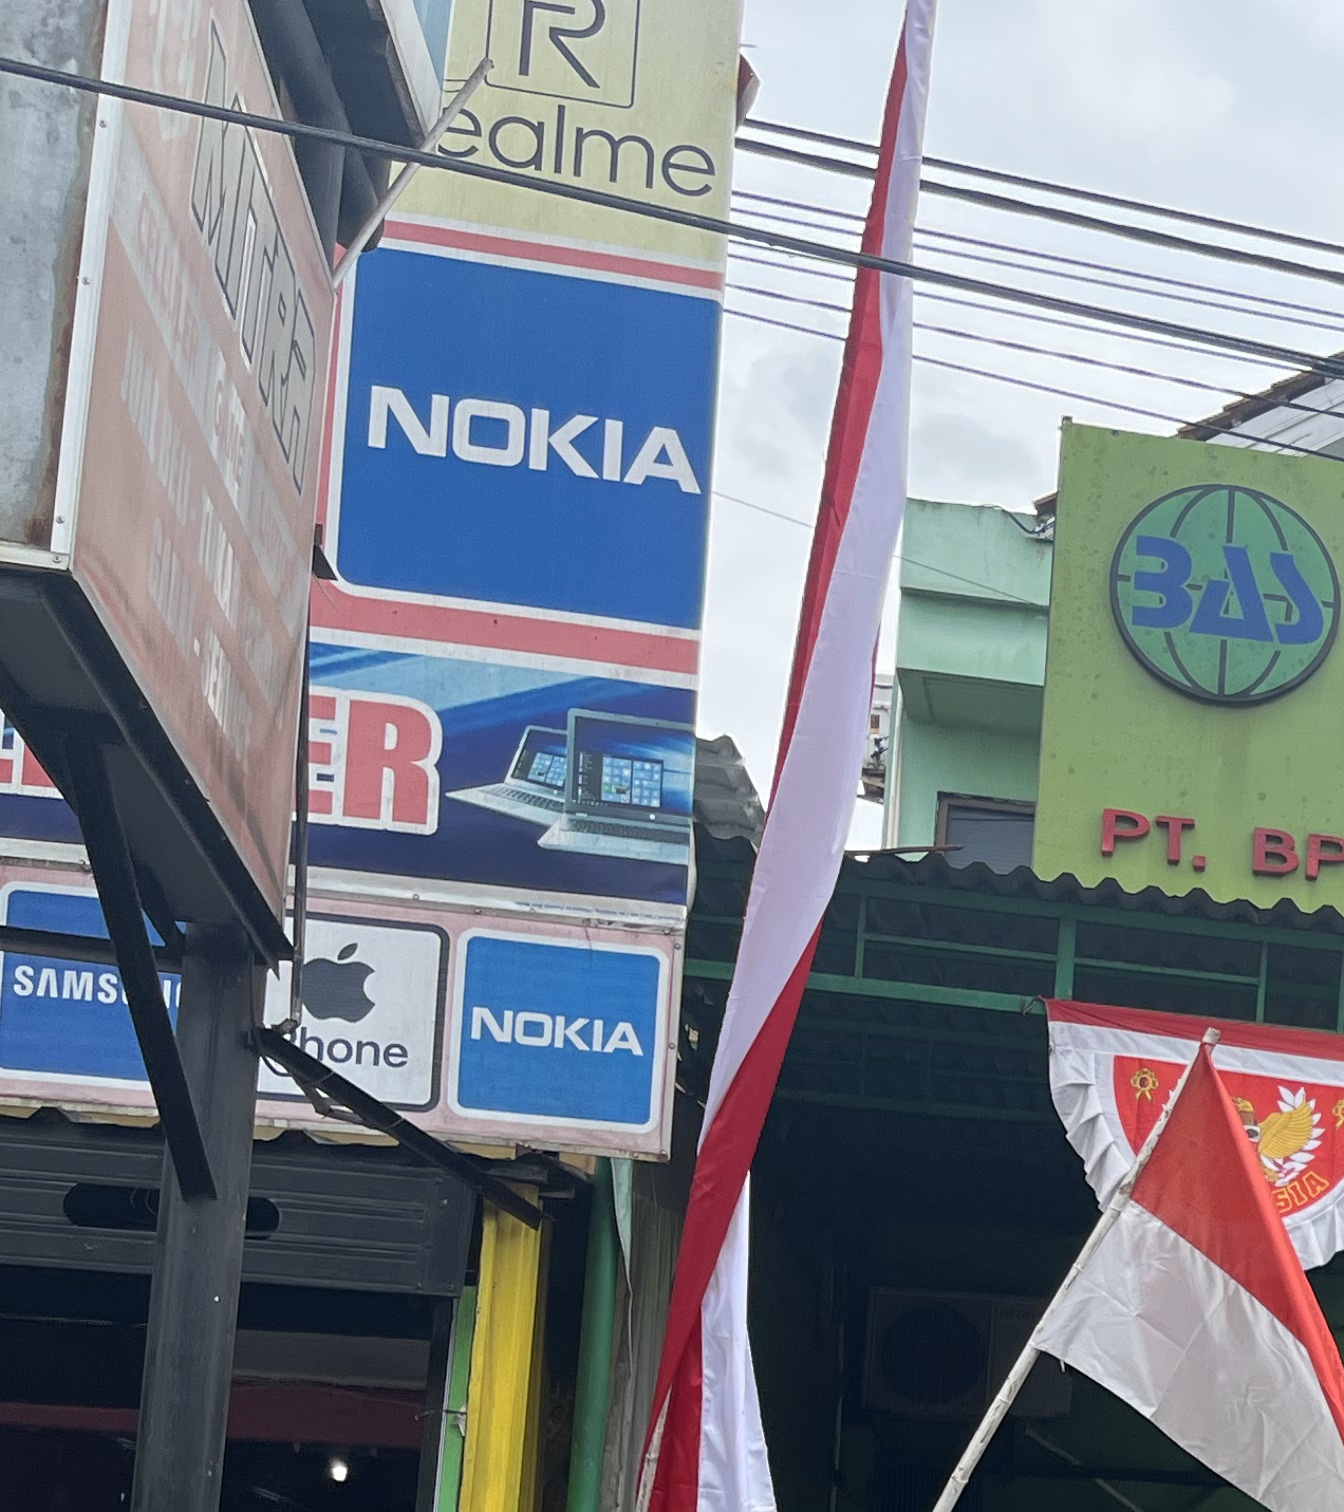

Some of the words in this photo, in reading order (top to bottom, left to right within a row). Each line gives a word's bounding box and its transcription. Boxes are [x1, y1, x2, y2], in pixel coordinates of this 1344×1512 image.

[367, 384, 703, 495] NOKIA
[1100, 807, 1207, 871] PT.
[469, 1004, 645, 1058] NOKIA
